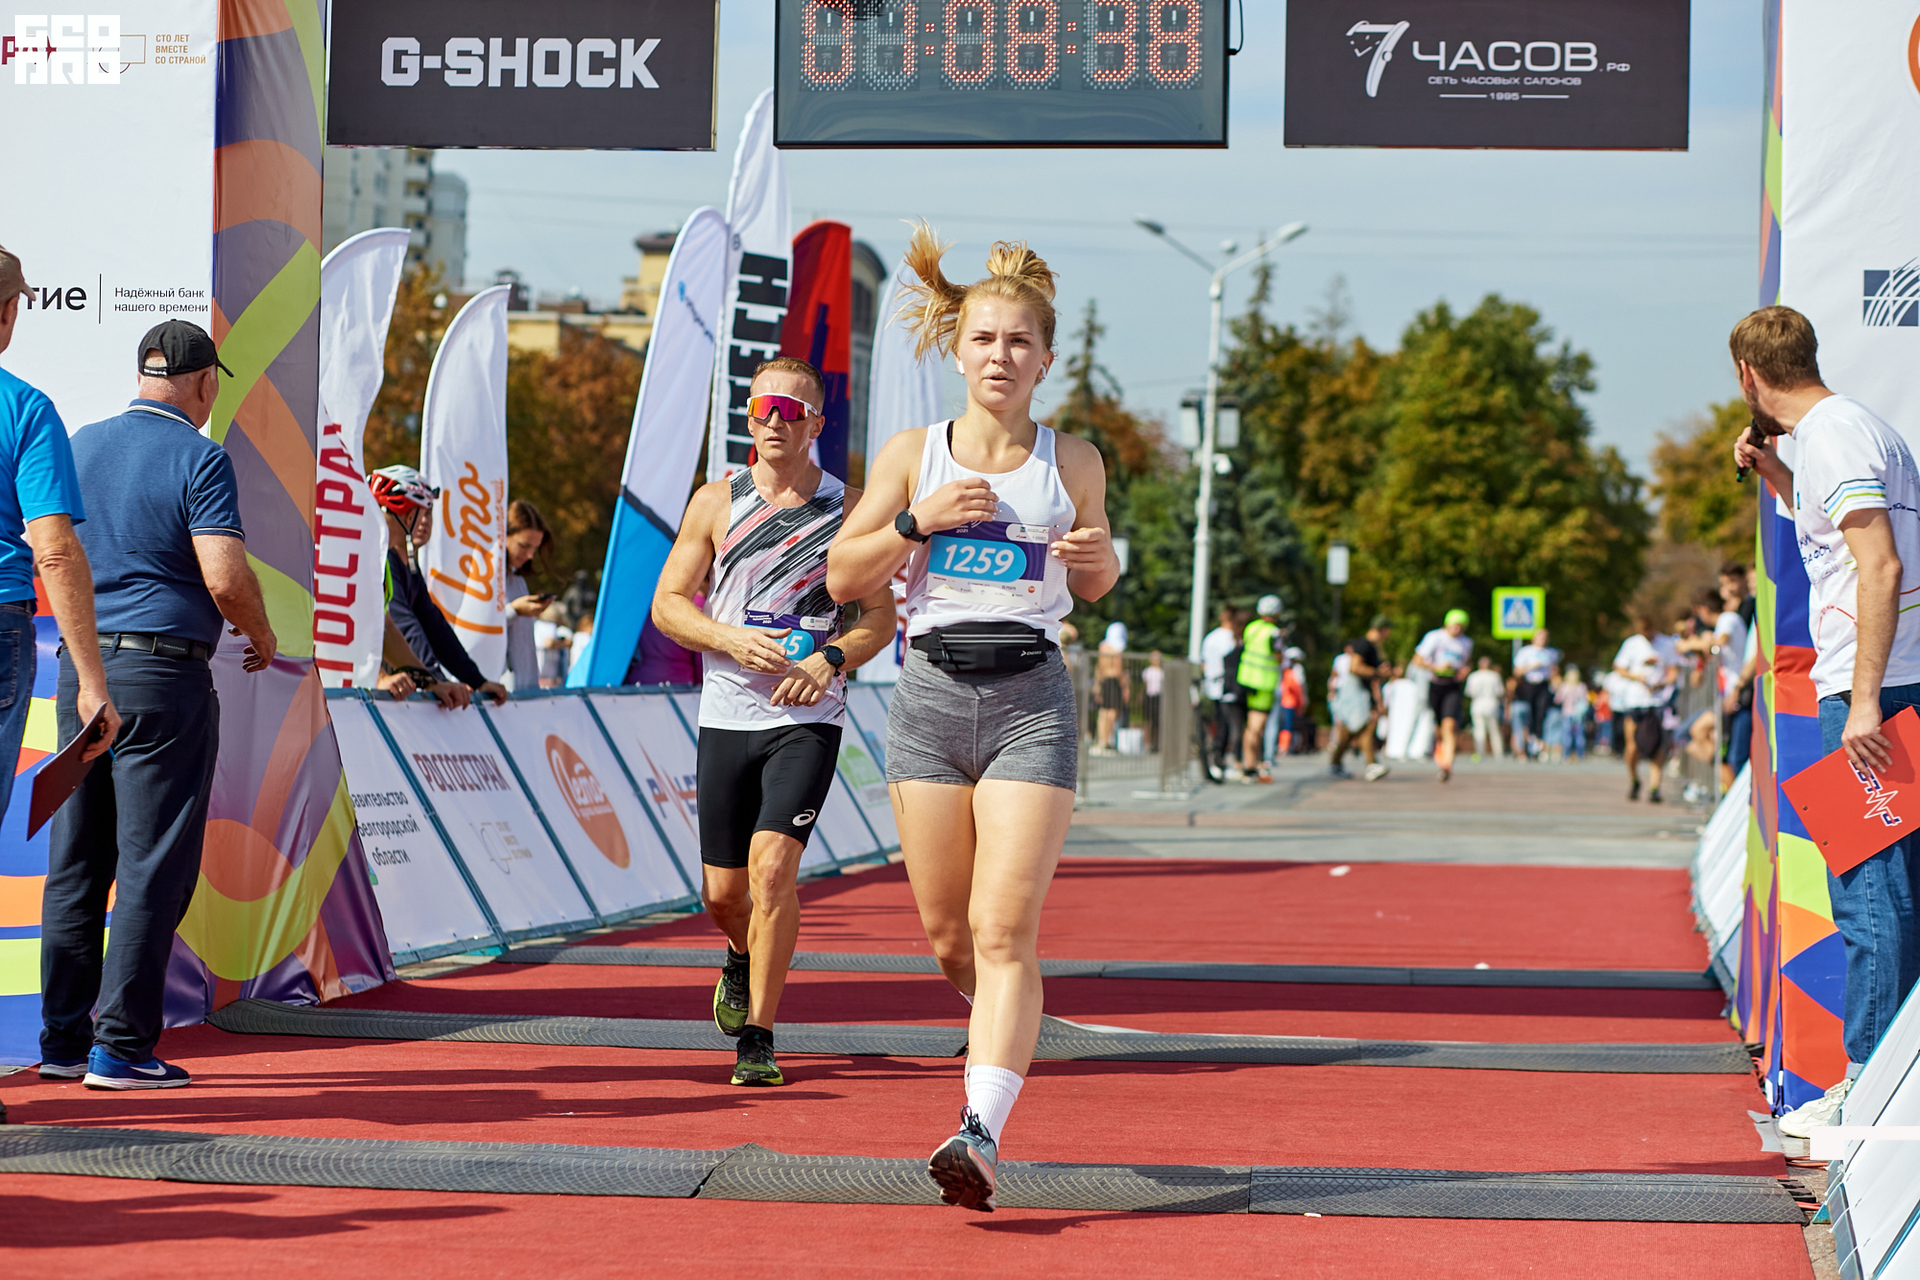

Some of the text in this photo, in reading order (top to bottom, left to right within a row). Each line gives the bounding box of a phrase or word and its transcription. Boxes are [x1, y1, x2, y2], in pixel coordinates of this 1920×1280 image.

[155, 34, 190, 43] СТО ЛЕТ
[155, 45, 188, 54] ВМЕСТЕ
[155, 54, 206, 65] СО СТРАНОЙ
[380, 36, 662, 89] G-SHOCK
[1346, 20, 1411, 98] 7
[1412, 41, 1598, 72] ЧАСОВ
[1427, 76, 1582, 86] СЕТЬ ЧАСОВЫХ САЛОНОВ
[115, 286, 205, 298] Надёжный банк
[114, 302, 209, 314] нашего времени
[944, 544, 1015, 576] 1259
[372, 846, 411, 866] области
